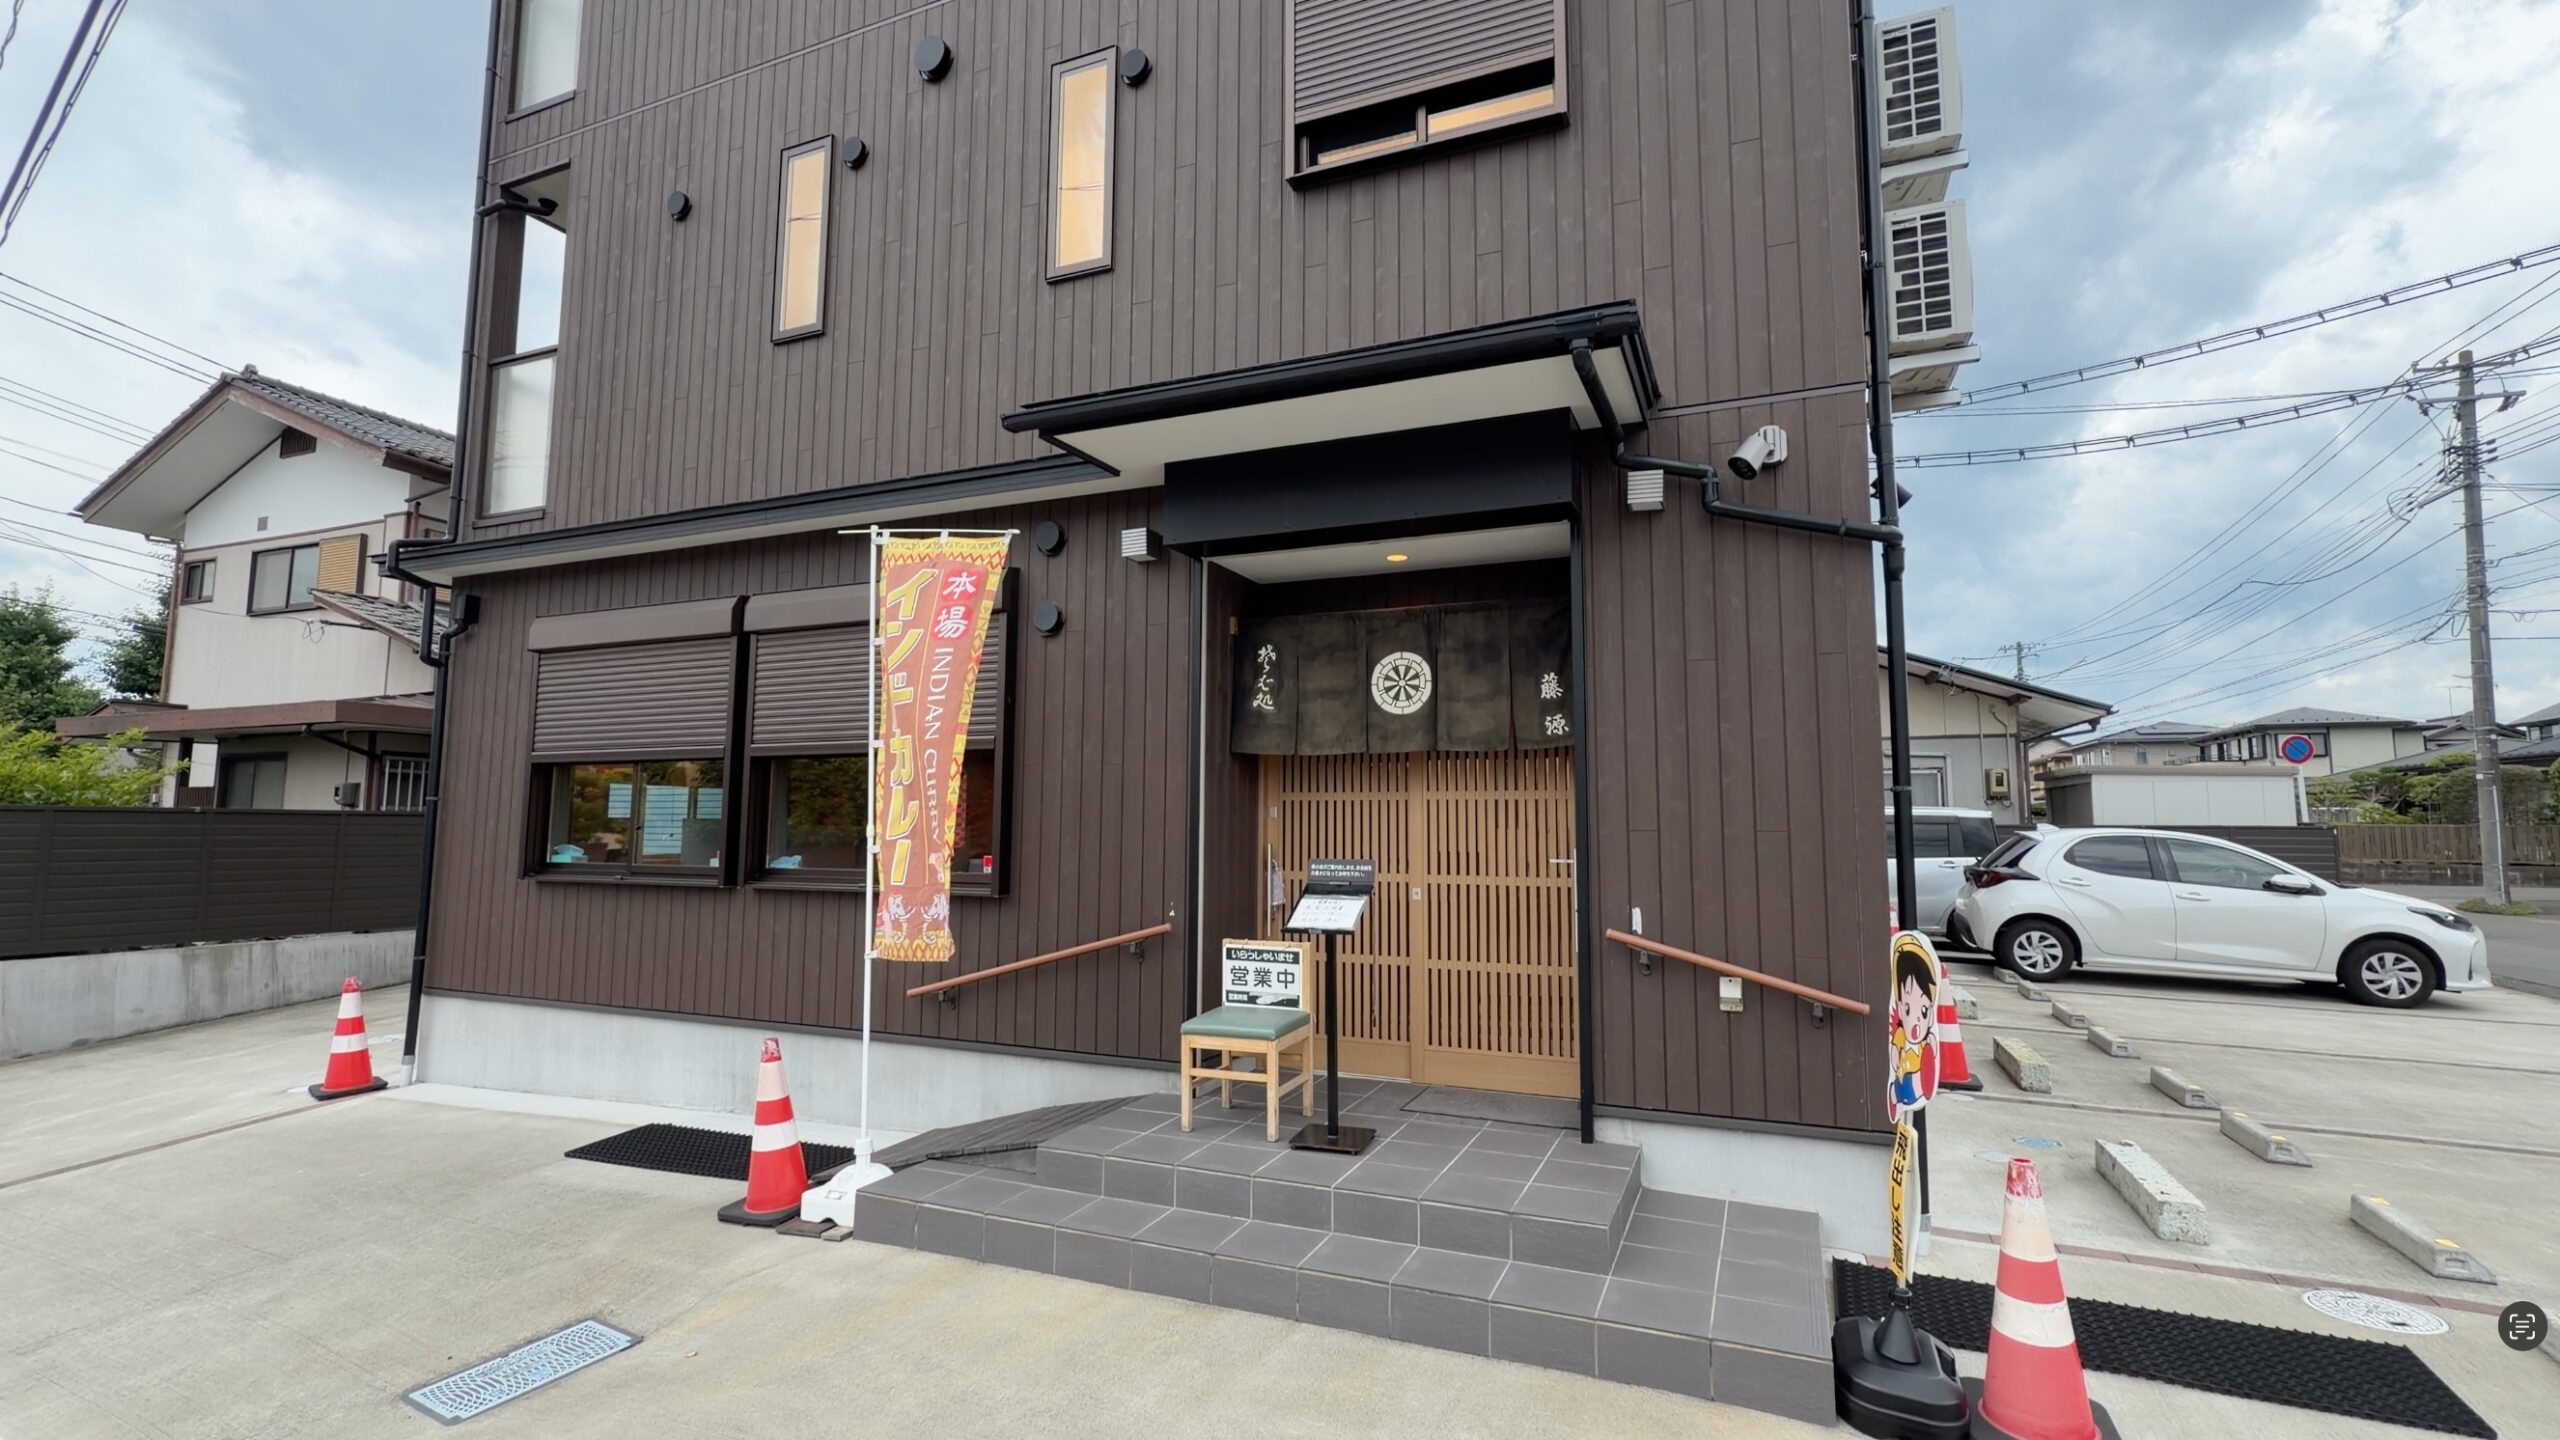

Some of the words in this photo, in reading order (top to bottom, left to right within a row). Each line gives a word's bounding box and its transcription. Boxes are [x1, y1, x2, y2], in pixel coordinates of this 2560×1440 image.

[933, 571, 978, 639] 本場
[885, 568, 939, 886] インドカレー
[924, 647, 954, 741] INDIAN
[923, 748, 943, 844] CURRY
[1230, 965, 1295, 990] 営業中
[1231, 949, 1295, 962] いらっしゃいませ
